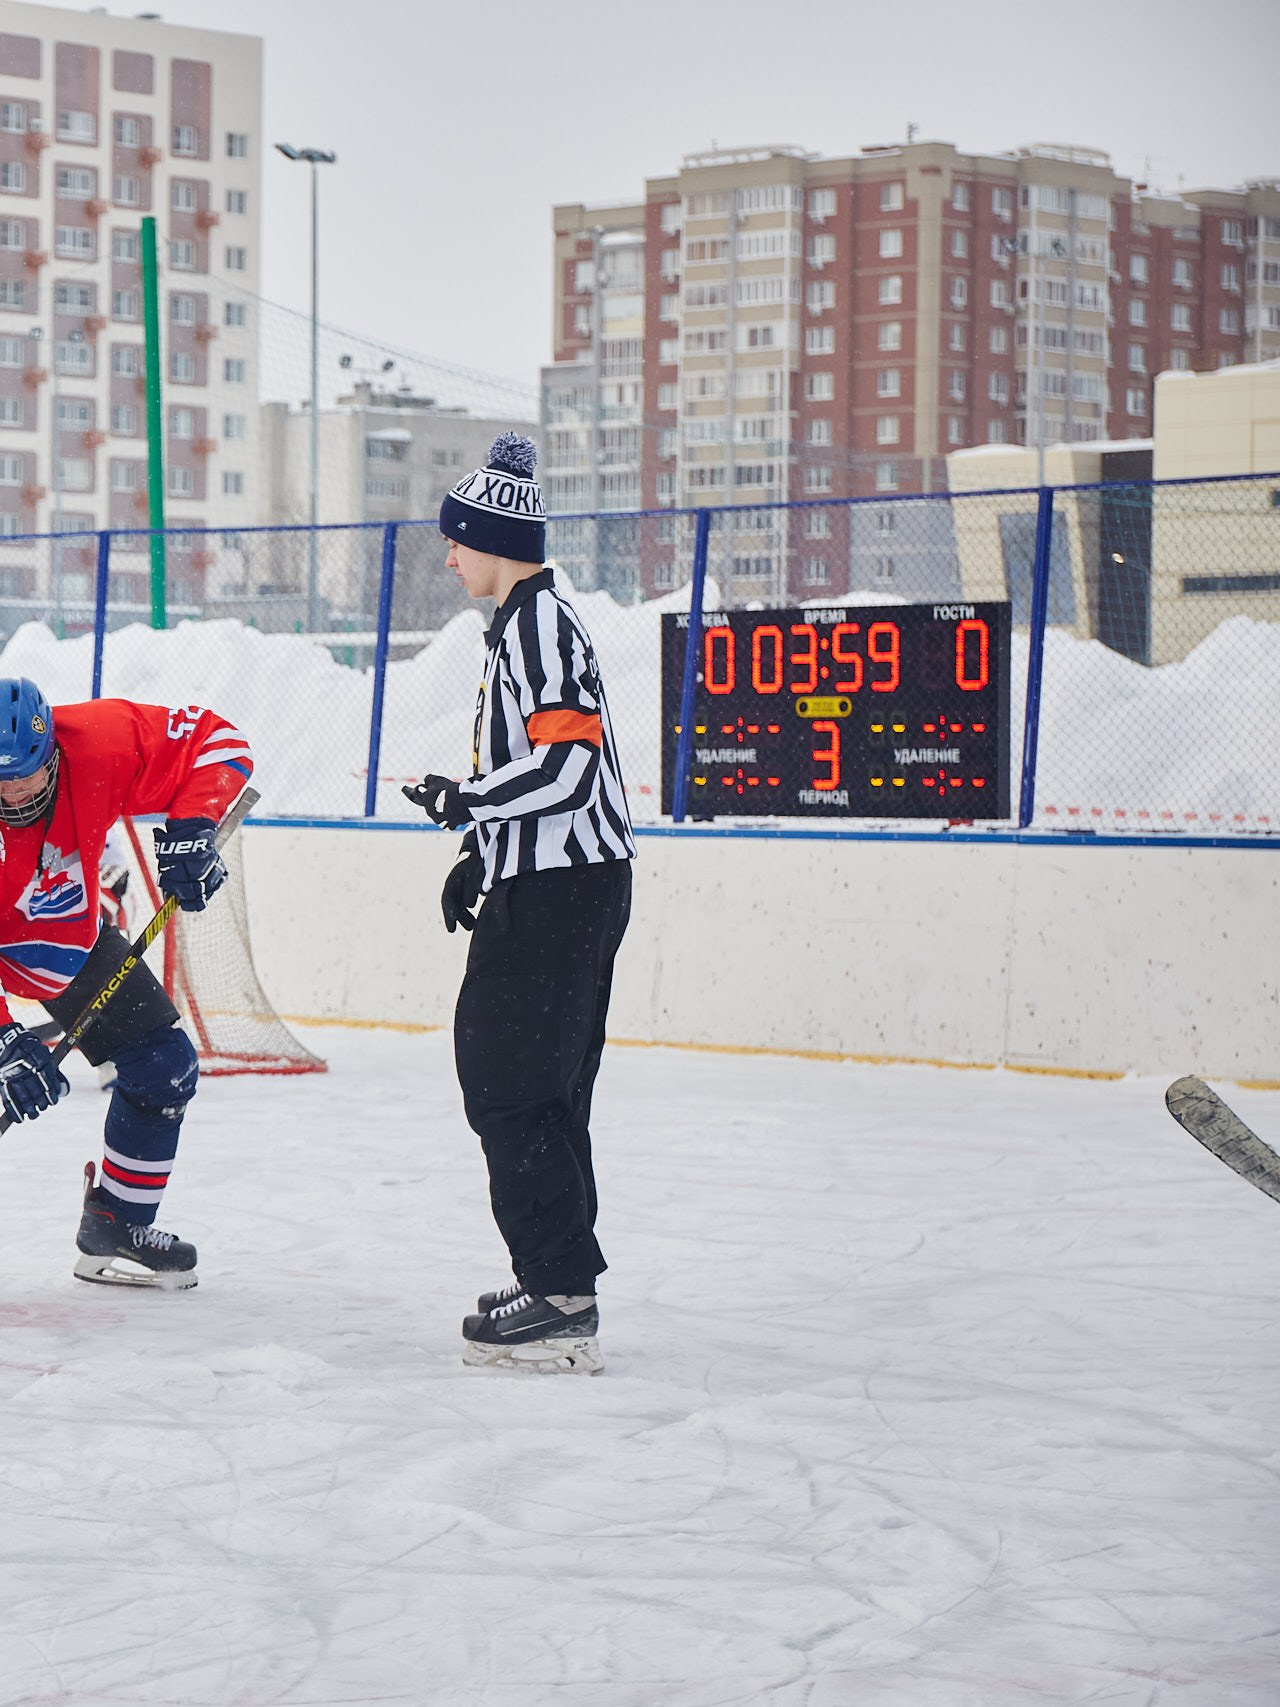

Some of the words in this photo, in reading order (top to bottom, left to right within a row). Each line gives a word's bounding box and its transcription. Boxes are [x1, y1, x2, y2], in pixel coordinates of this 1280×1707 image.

[804, 609, 847, 625] ВРЕМЯ
[933, 605, 975, 621] ГОСТИ
[704, 625, 736, 695] 0
[751, 621, 901, 695] 03:59
[955, 619, 990, 692] 0
[695, 748, 758, 765] УДАЛЕНИЕ
[811, 720, 841, 791] 3
[894, 748, 961, 765] УДАЛЕНИЕ
[799, 789, 850, 808] ПЕРИОД
[91, 955, 137, 1011] TACKS
